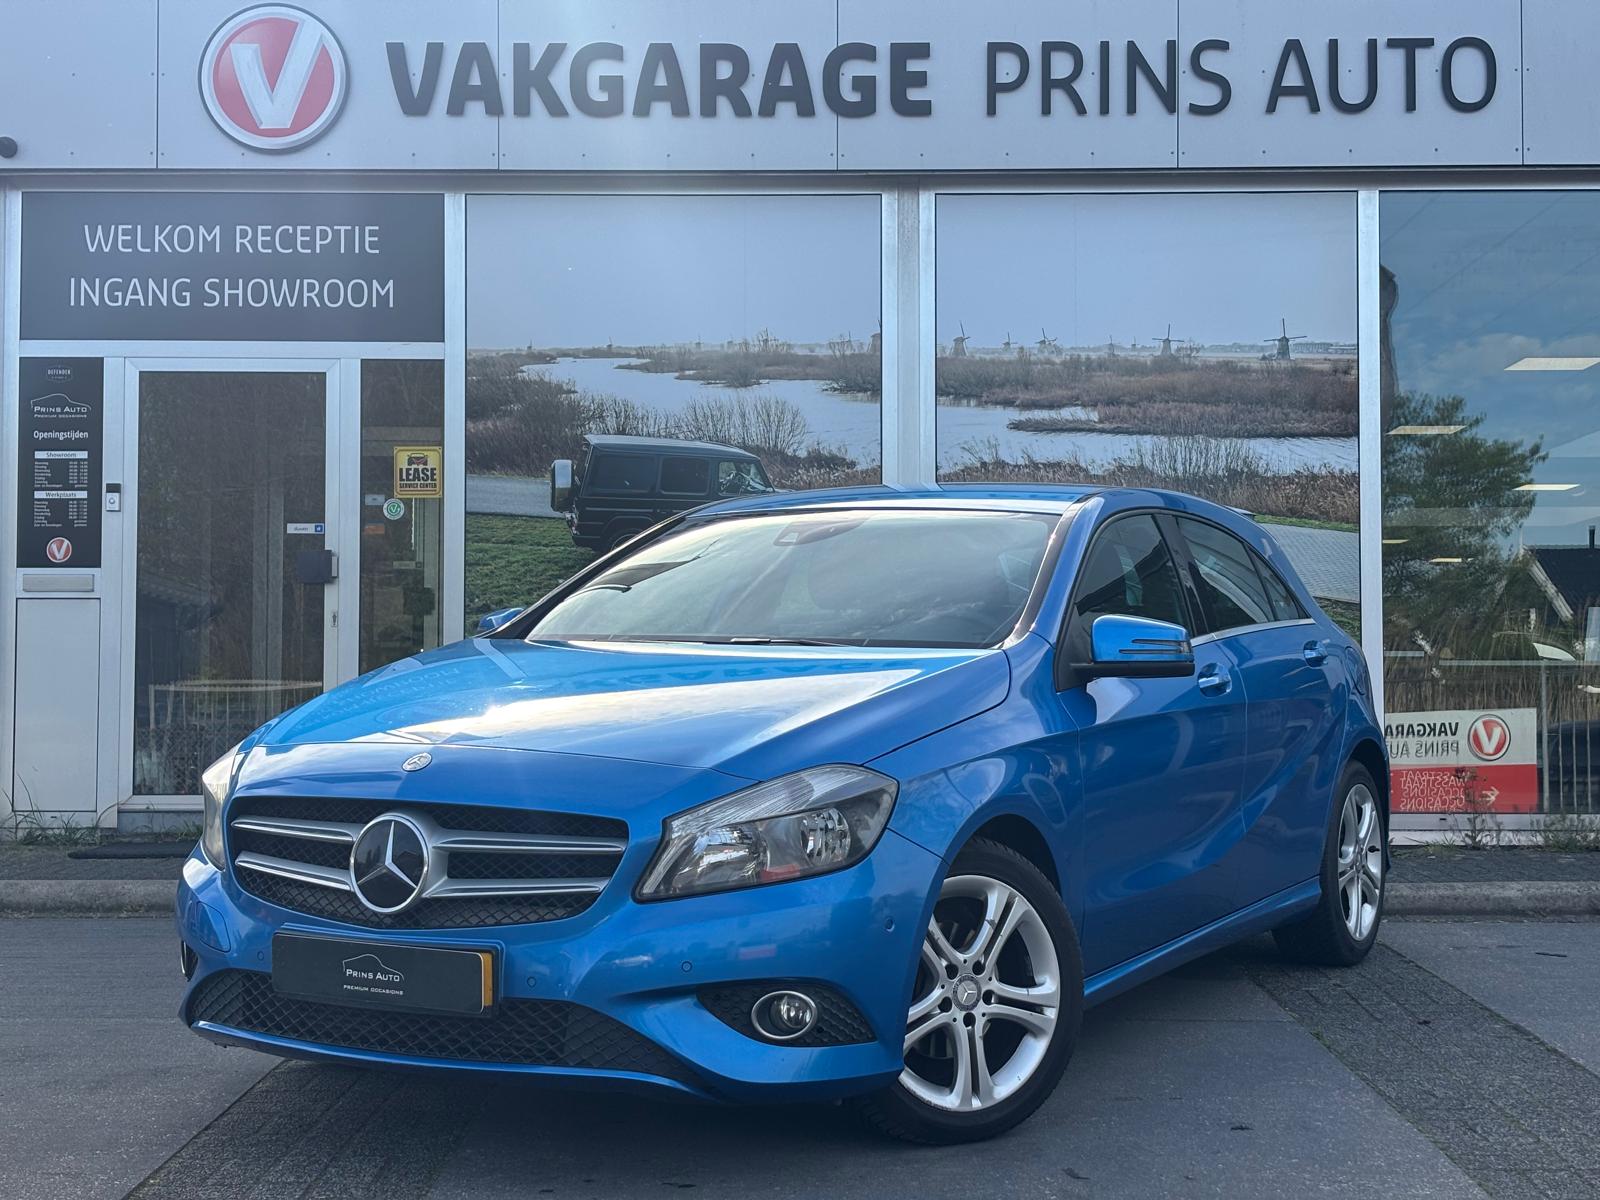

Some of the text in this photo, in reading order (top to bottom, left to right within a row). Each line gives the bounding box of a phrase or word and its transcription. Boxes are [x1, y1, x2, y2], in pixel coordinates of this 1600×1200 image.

[386, 37, 1497, 117] VAKGARAGE PRINS AUTO
[84, 225, 380, 254] WELKOM RECEPTIE
[69, 277, 395, 308] INGANG SHOWROOM
[33, 430, 89, 440] Openingstijden
[399, 468, 437, 482] LEASE
[346, 968, 400, 982] PRINS AUTO
[343, 984, 404, 995] PREMIUM OCCASIONS
